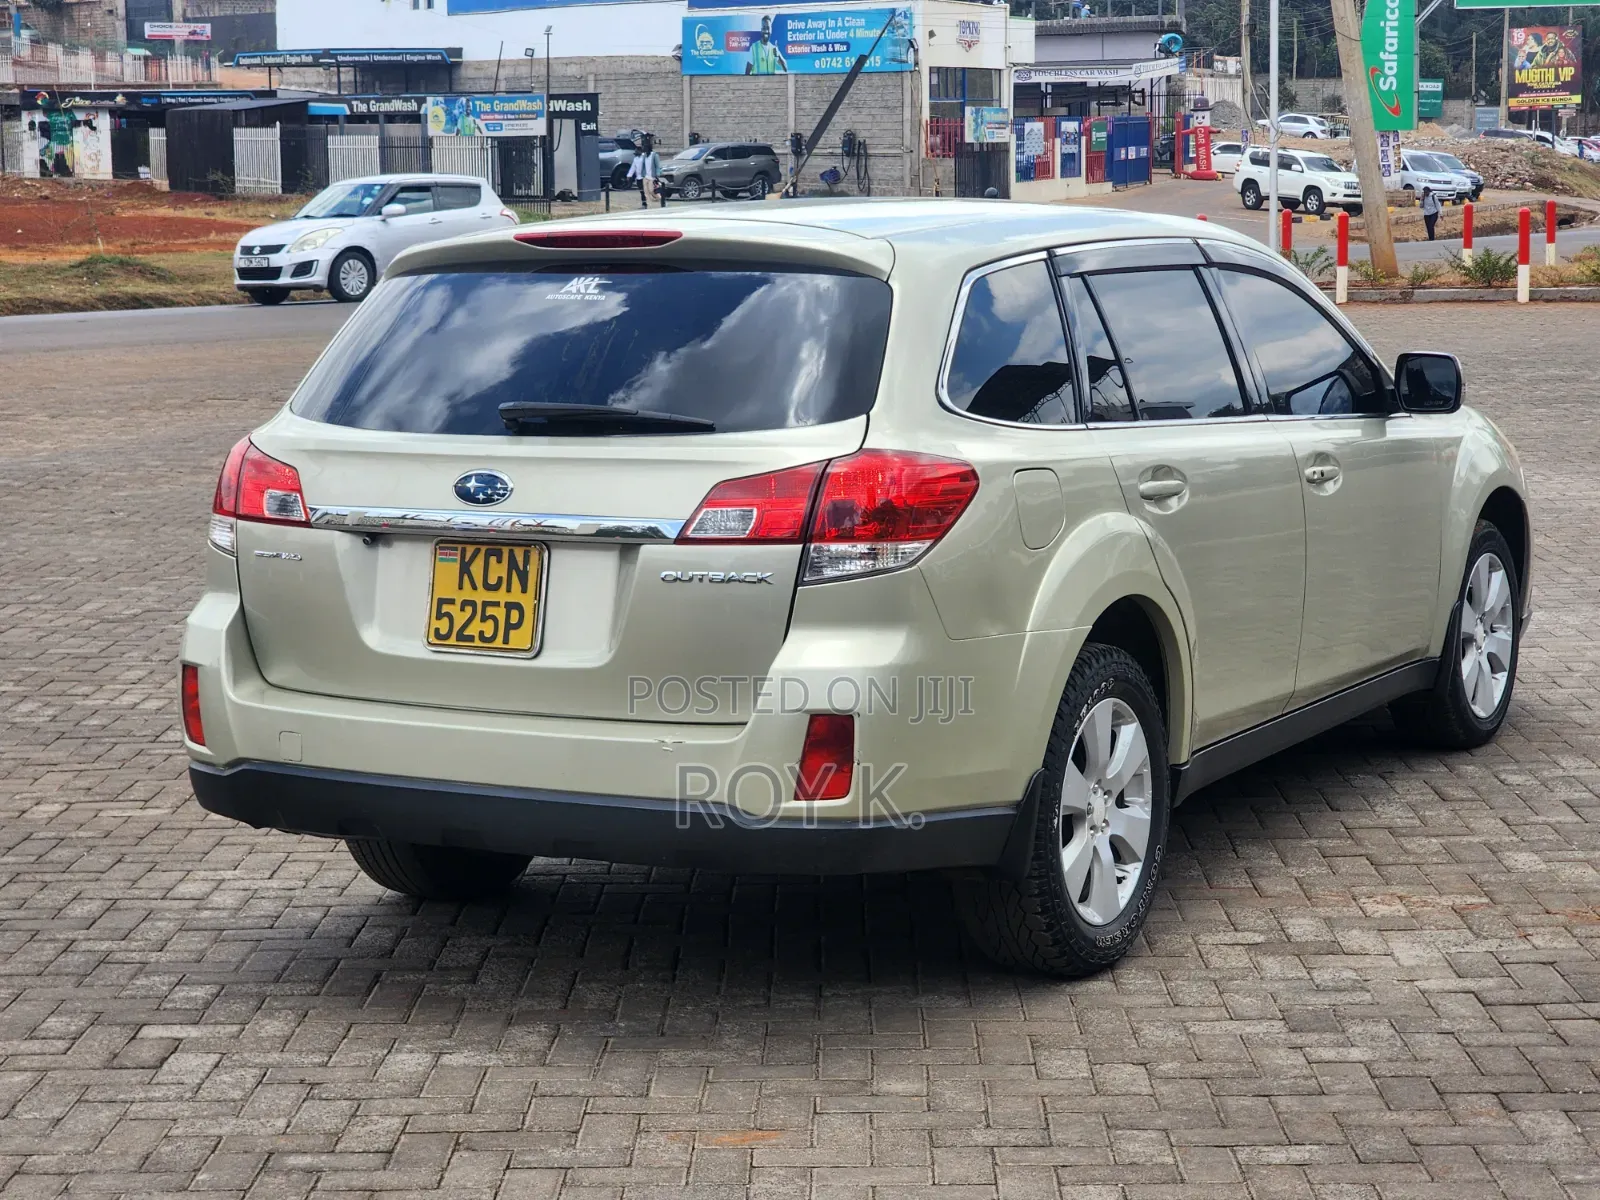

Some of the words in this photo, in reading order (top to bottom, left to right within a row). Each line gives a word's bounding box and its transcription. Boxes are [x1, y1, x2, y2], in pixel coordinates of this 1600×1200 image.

[787, 20, 805, 30] Drive
[807, 19, 826, 31] Away
[828, 18, 835, 28] In
[837, 18, 843, 27] A
[844, 17, 865, 27] Clean
[959, 20, 981, 35] TOPKING
[787, 31, 815, 41] Exterior
[817, 30, 825, 40] In
[826, 29, 848, 40] Under
[849, 30, 854, 38] 4
[1513, 32, 1525, 41] 19
[788, 45, 811, 53] Exterior
[811, 44, 827, 52] Wash
[834, 44, 847, 52] Wax
[286, 54, 301, 64] Engine
[301, 54, 313, 63] Wash
[406, 54, 425, 62] Engine
[821, 58, 842, 68] 0742
[1515, 68, 1555, 83] MUGITHI
[1558, 67, 1575, 81] VIP
[351, 101, 368, 112] The
[369, 99, 417, 112] GrandWash
[475, 101, 491, 112] The
[493, 99, 542, 111] GrandWash
[581, 122, 597, 130] Exit
[1196, 128, 1205, 144] CAR
[1198, 147, 1207, 170] WASH
[458, 547, 531, 594] KCN
[660, 570, 774, 585] OUTBACK
[434, 597, 525, 645] 525P
